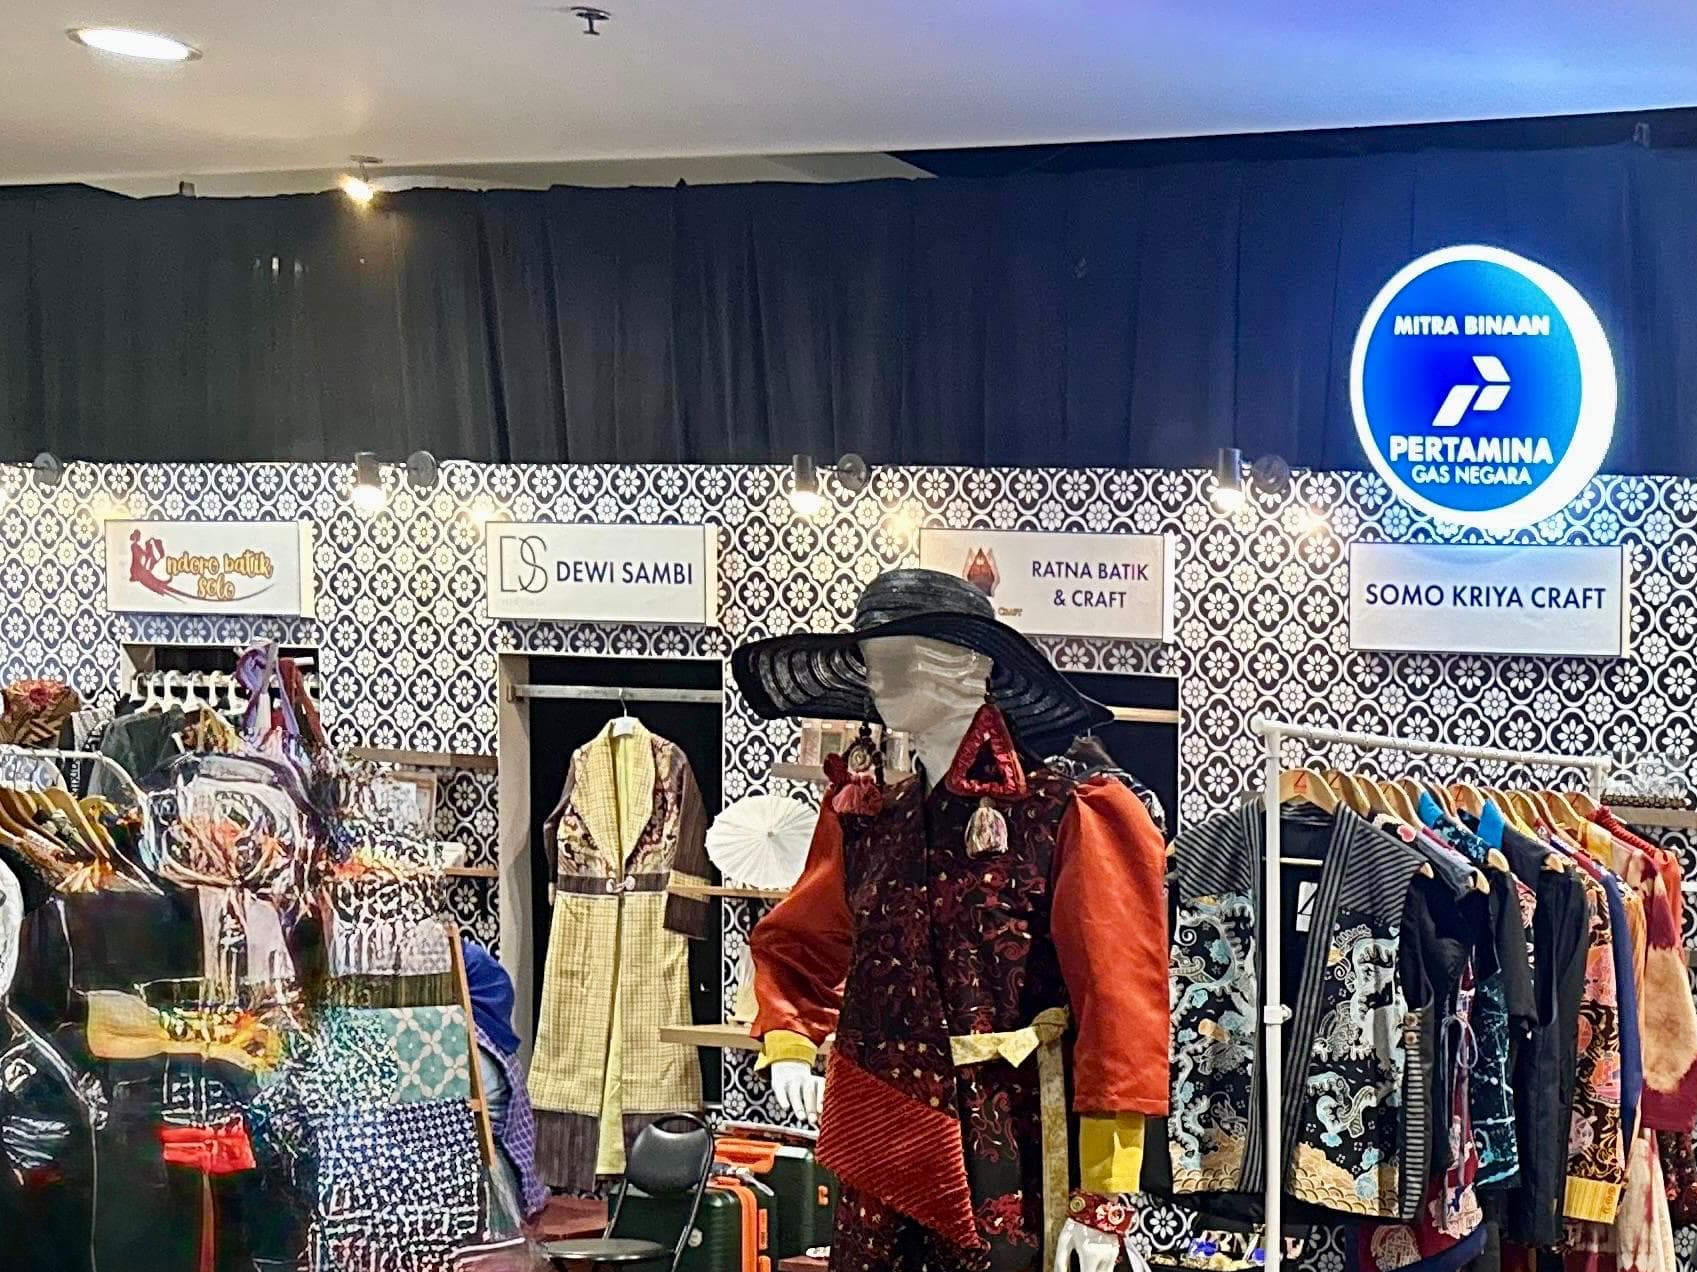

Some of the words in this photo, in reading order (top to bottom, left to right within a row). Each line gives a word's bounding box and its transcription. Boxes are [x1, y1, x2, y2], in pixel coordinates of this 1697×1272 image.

[1394, 315, 1459, 336] MITRA
[1464, 315, 1550, 336] BINAAN
[1389, 435, 1554, 464] PERTAMINA
[1411, 465, 1450, 484] GAS
[1455, 466, 1533, 485] NEGARA
[165, 551, 220, 576] ndoro
[224, 549, 274, 579] batik
[556, 560, 614, 583] DEWI
[622, 562, 692, 585] SAMBI
[1031, 560, 1092, 580] RATNA
[1099, 563, 1149, 581] BATIK
[197, 573, 235, 600] solo
[1053, 589, 1066, 607] &
[1071, 590, 1127, 609] CRAFT
[1365, 583, 1444, 606] SOMO
[1453, 585, 1523, 608] KRIYA
[1531, 586, 1606, 609] CRAFT
